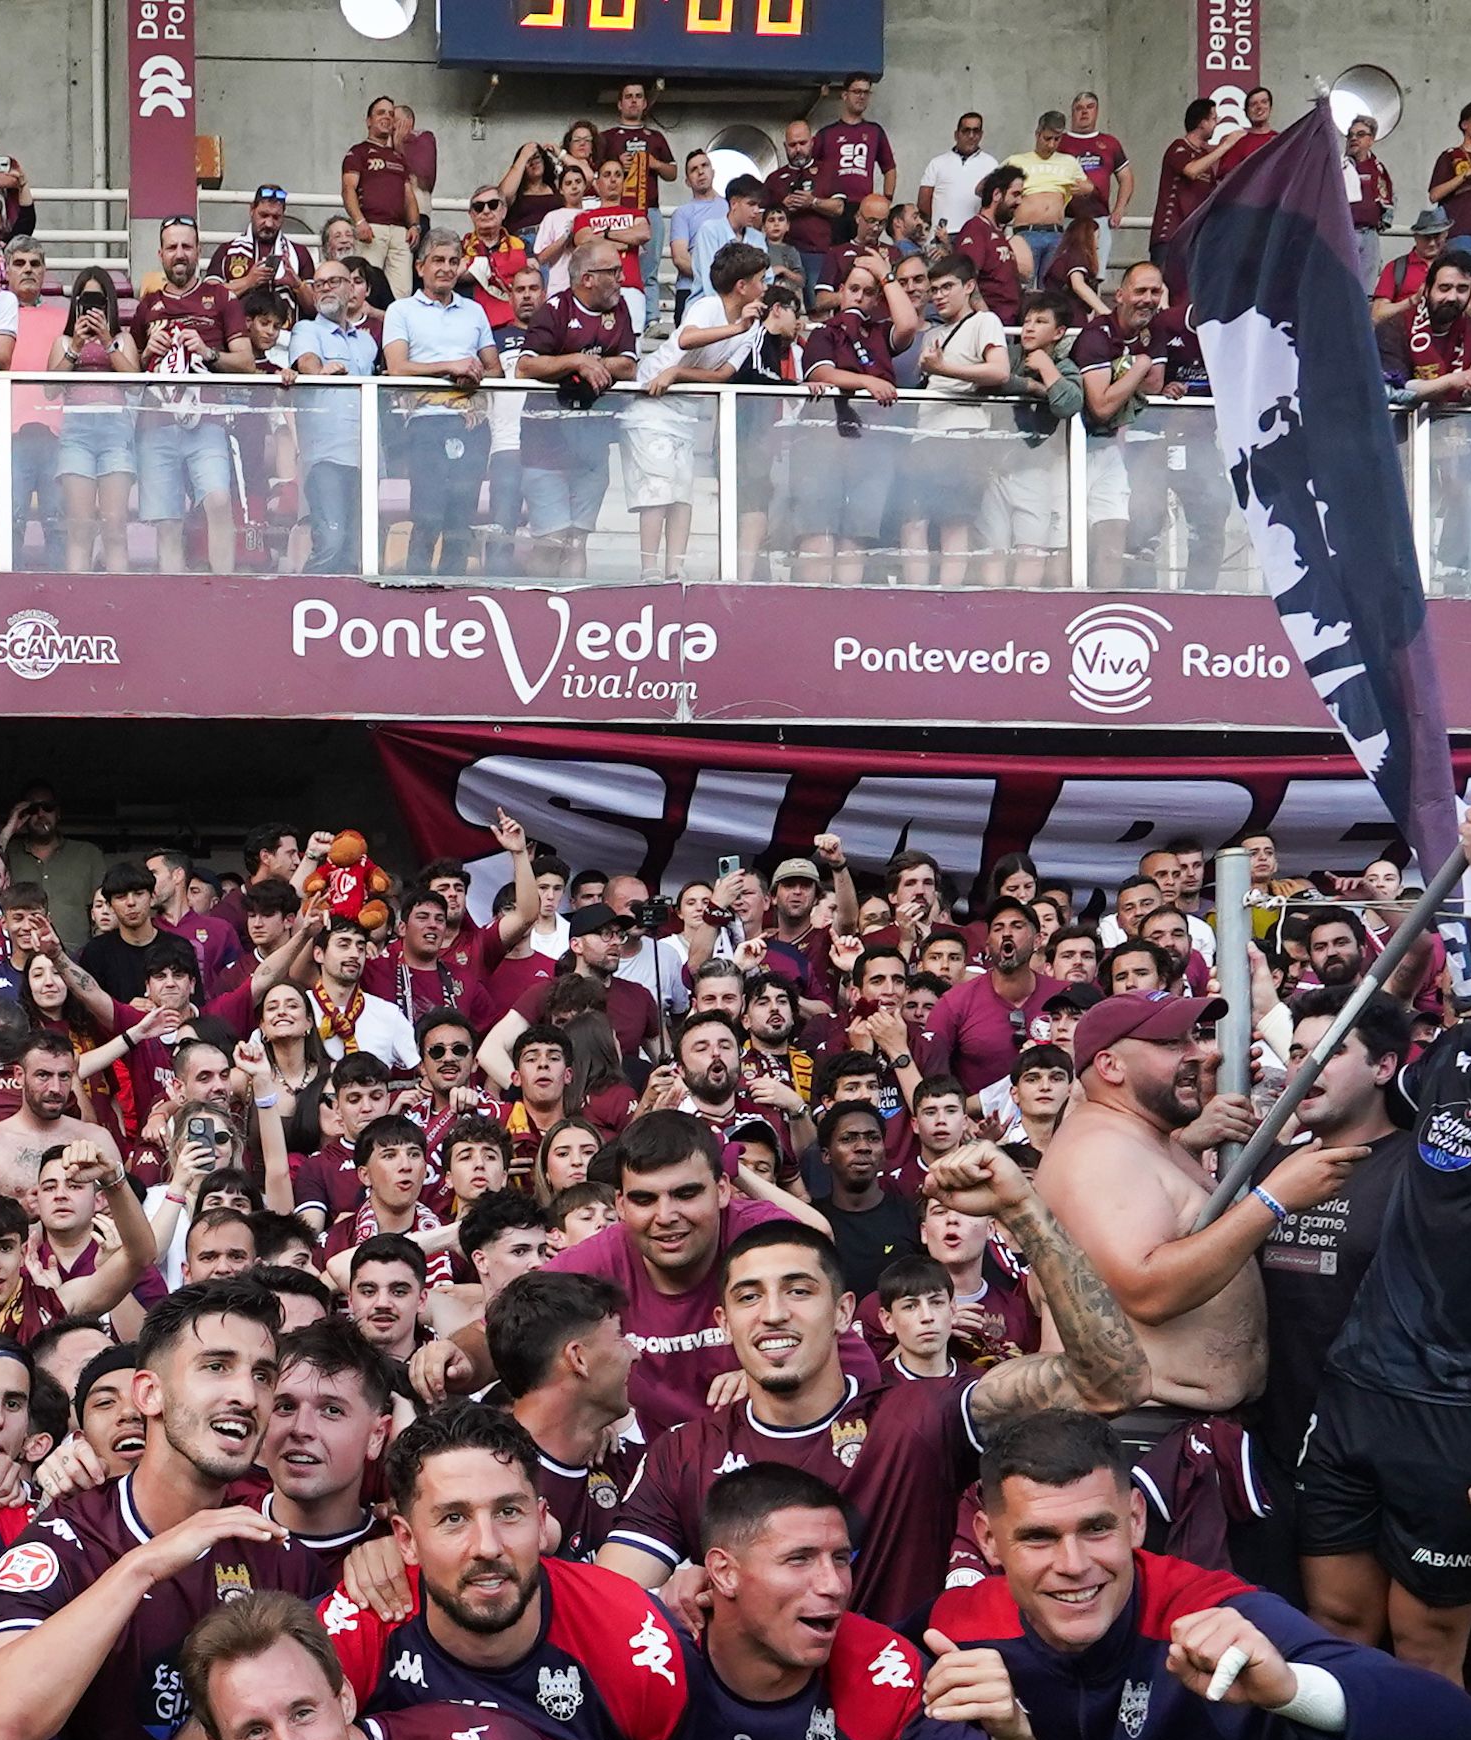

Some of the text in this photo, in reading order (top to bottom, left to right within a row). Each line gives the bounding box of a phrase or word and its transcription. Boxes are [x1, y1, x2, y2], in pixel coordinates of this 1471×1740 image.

[834, 635, 1292, 680] Pontevedra Viva Radio
[1298, 1216, 1348, 1235] game,
[1299, 1228, 1338, 1247] beer.
